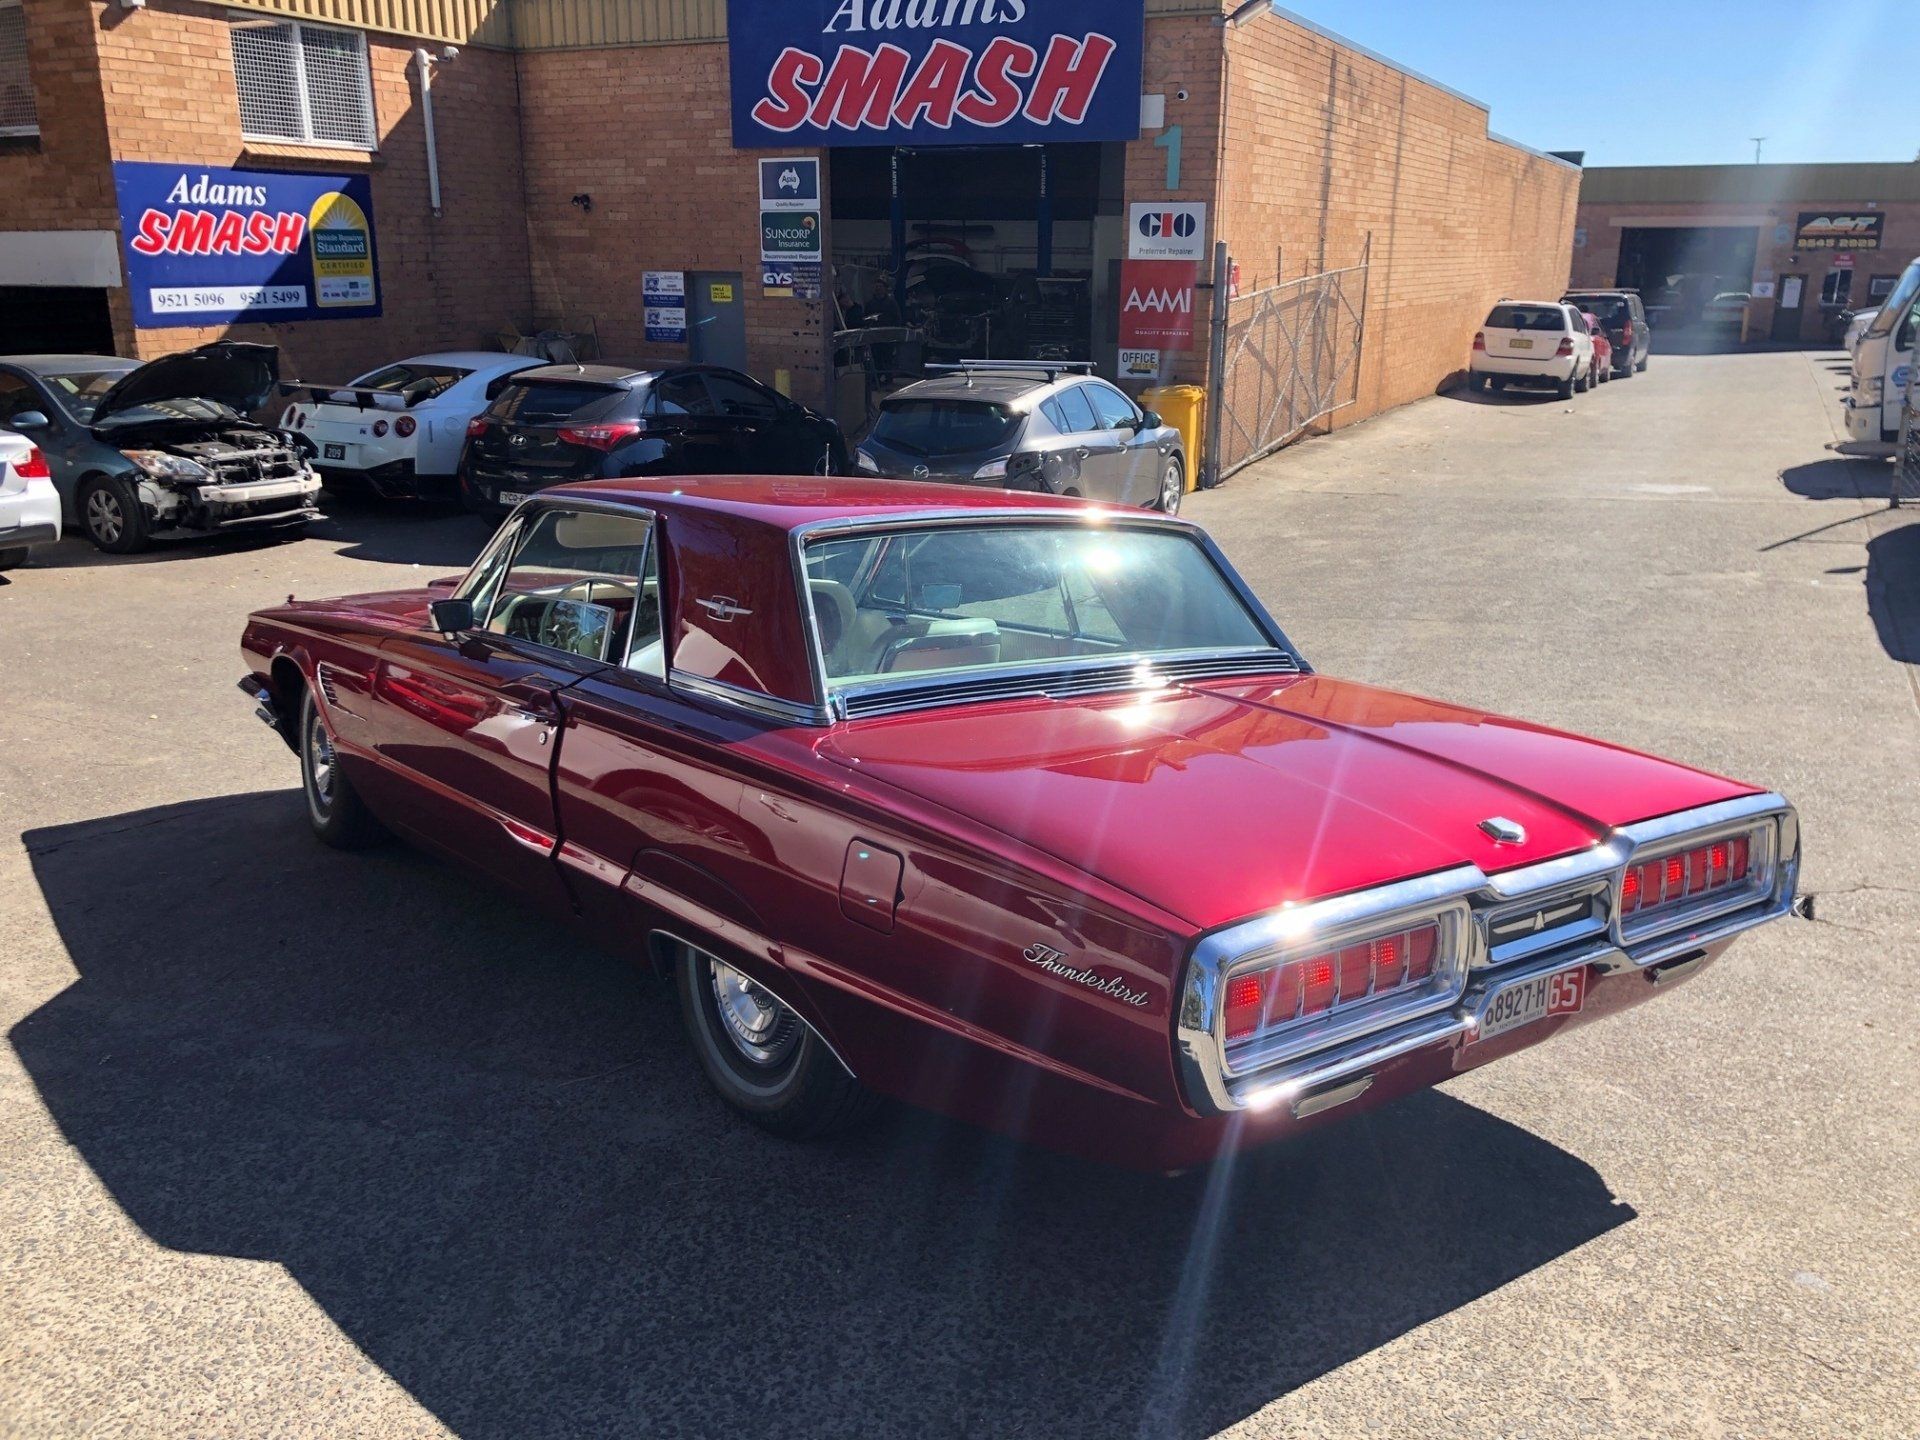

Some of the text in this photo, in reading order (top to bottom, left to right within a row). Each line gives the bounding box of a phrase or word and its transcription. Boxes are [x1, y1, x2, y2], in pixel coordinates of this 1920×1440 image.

[751, 32, 1116, 132] SMASH
[1154, 124, 1182, 190] 1
[167, 174, 266, 206] Adams
[131, 208, 306, 256] SMASH
[765, 227, 811, 239] SUNCORP
[1139, 212, 1196, 238] GIO
[317, 241, 365, 253] Standard
[779, 240, 810, 248] Insurance
[1139, 247, 1194, 256] Preferred Repairer
[320, 262, 365, 270] CERTIFIED
[763, 272, 793, 285] GYS
[158, 291, 300, 307] 9521 5096 9521 5499
[1124, 287, 1190, 313] AAMI
[1122, 352, 1156, 363] OFFICE
[1023, 943, 1148, 1007] Thunderbird
[1549, 972, 1579, 1010] 65
